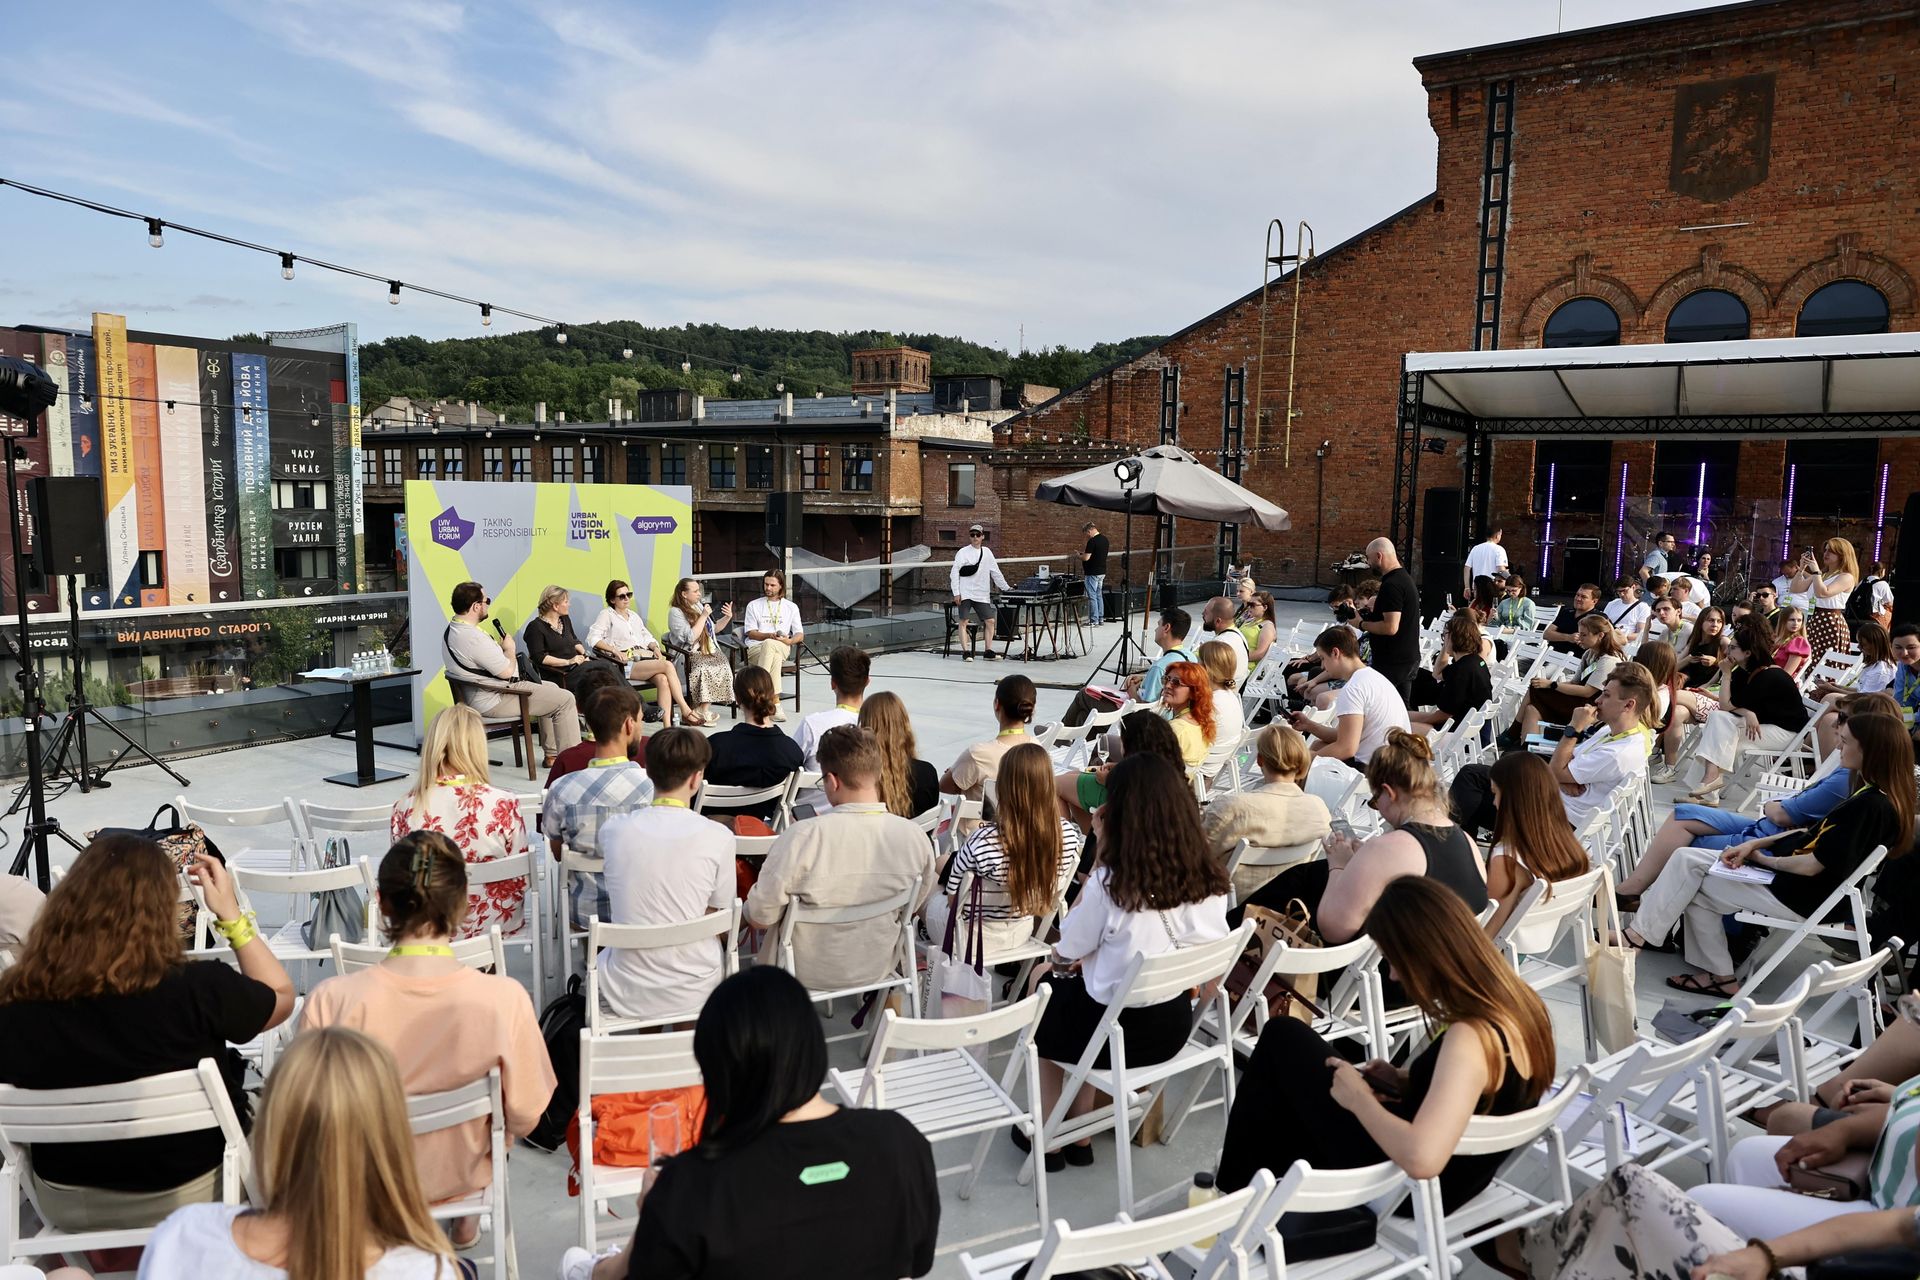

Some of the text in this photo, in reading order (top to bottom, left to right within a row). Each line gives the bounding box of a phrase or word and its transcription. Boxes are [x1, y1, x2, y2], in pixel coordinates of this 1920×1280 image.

[240, 365, 251, 398] ЙОВА
[253, 365, 265, 494] ХРОНІКИ ВТОРГНЕННЯ
[291, 449, 315, 459] ЧАСУ
[110, 458, 118, 473] МИ
[243, 429, 255, 494] ПОЗИВНИЙ
[284, 463, 320, 474] НЕМАЄ
[338, 503, 346, 519] ПРО
[288, 521, 323, 531] РУСТЕМ
[483, 518, 513, 527] TAKING
[571, 520, 603, 528] VISION
[292, 533, 320, 543] ХАЛІЛ
[483, 527, 548, 538] RESPONSIBILITY
[571, 530, 610, 540] LUTSK
[209, 504, 233, 577] Скарбничка
[250, 510, 258, 570] ОЛЕКСАНДР
[120, 541, 129, 565] Уляна
[259, 536, 267, 569] МИХЕД
[315, 612, 388, 624] ИГАРНЯ-КАВ'ЯРНЯ
